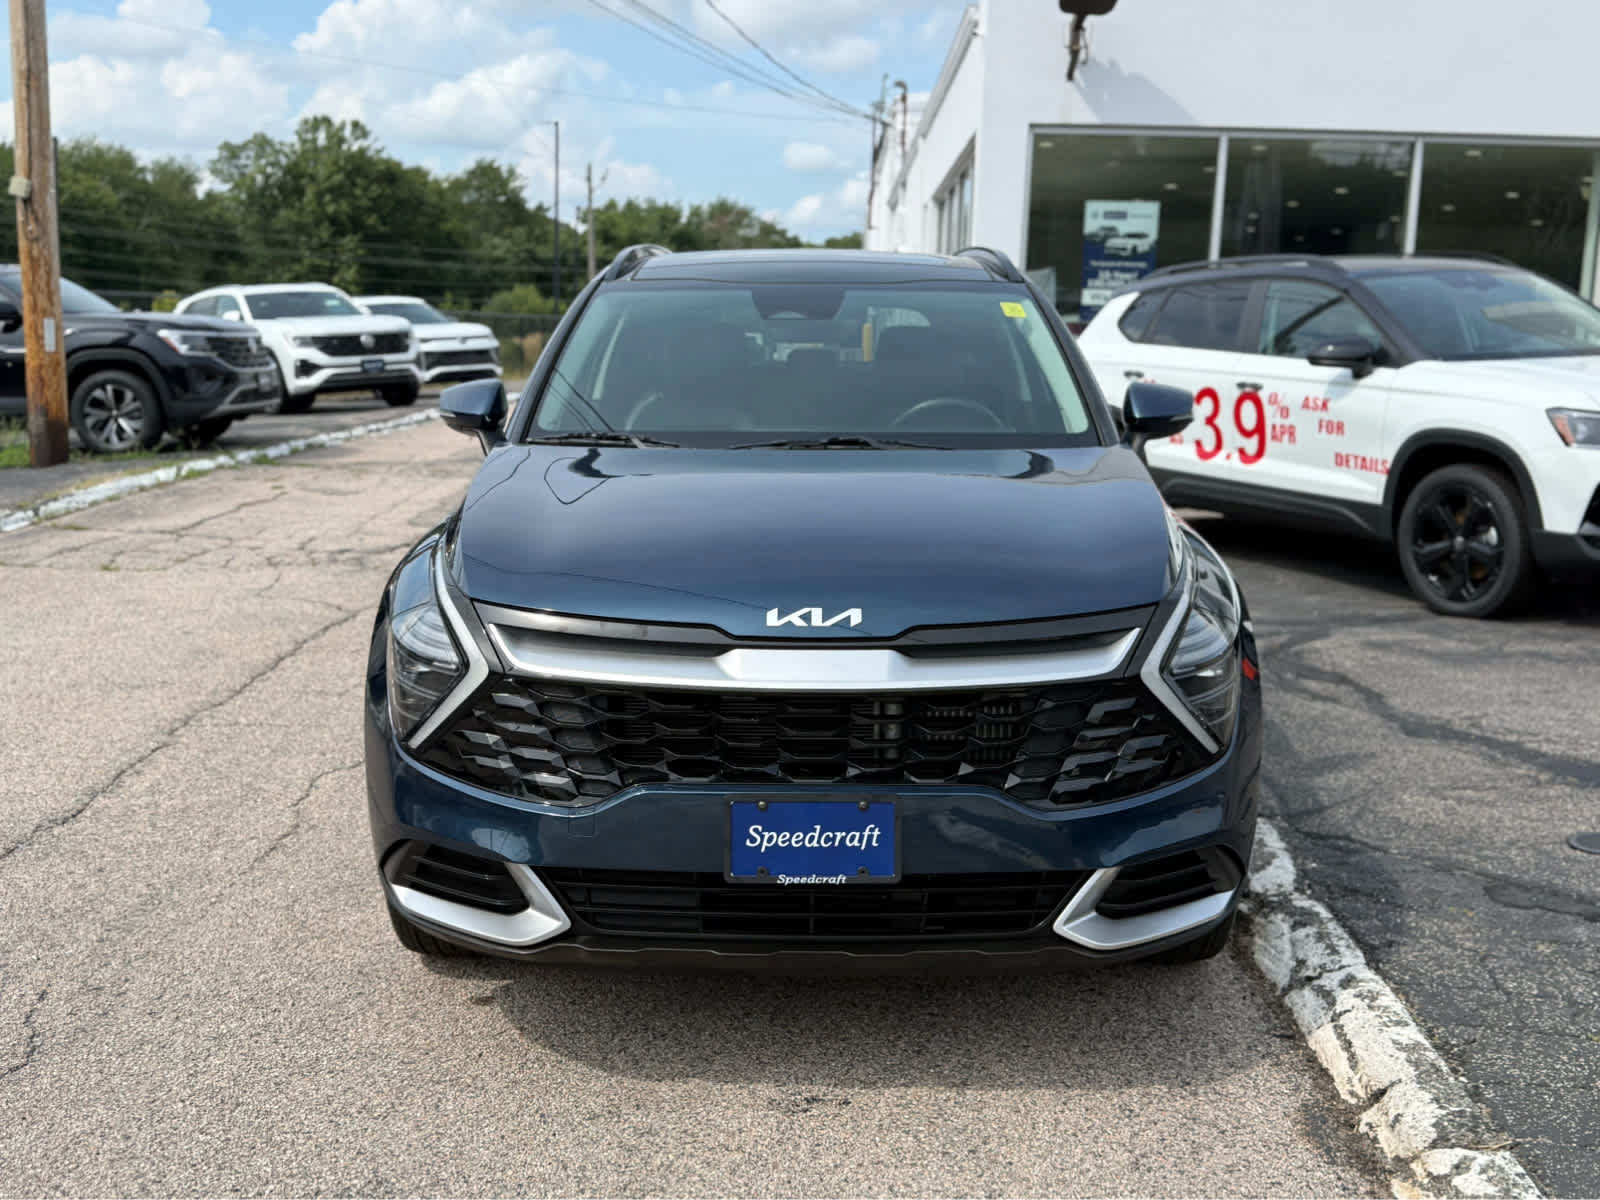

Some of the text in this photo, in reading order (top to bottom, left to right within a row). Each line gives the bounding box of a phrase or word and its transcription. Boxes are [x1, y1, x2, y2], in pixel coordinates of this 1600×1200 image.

[1301, 396, 1330, 412] ASK
[1271, 423, 1296, 444] APR
[1318, 419, 1345, 435] FOR
[1334, 452, 1390, 475] DETAILS
[766, 607, 863, 628] KIA
[745, 824, 881, 853] Speedcraft
[776, 874, 847, 886] Speedcraft
